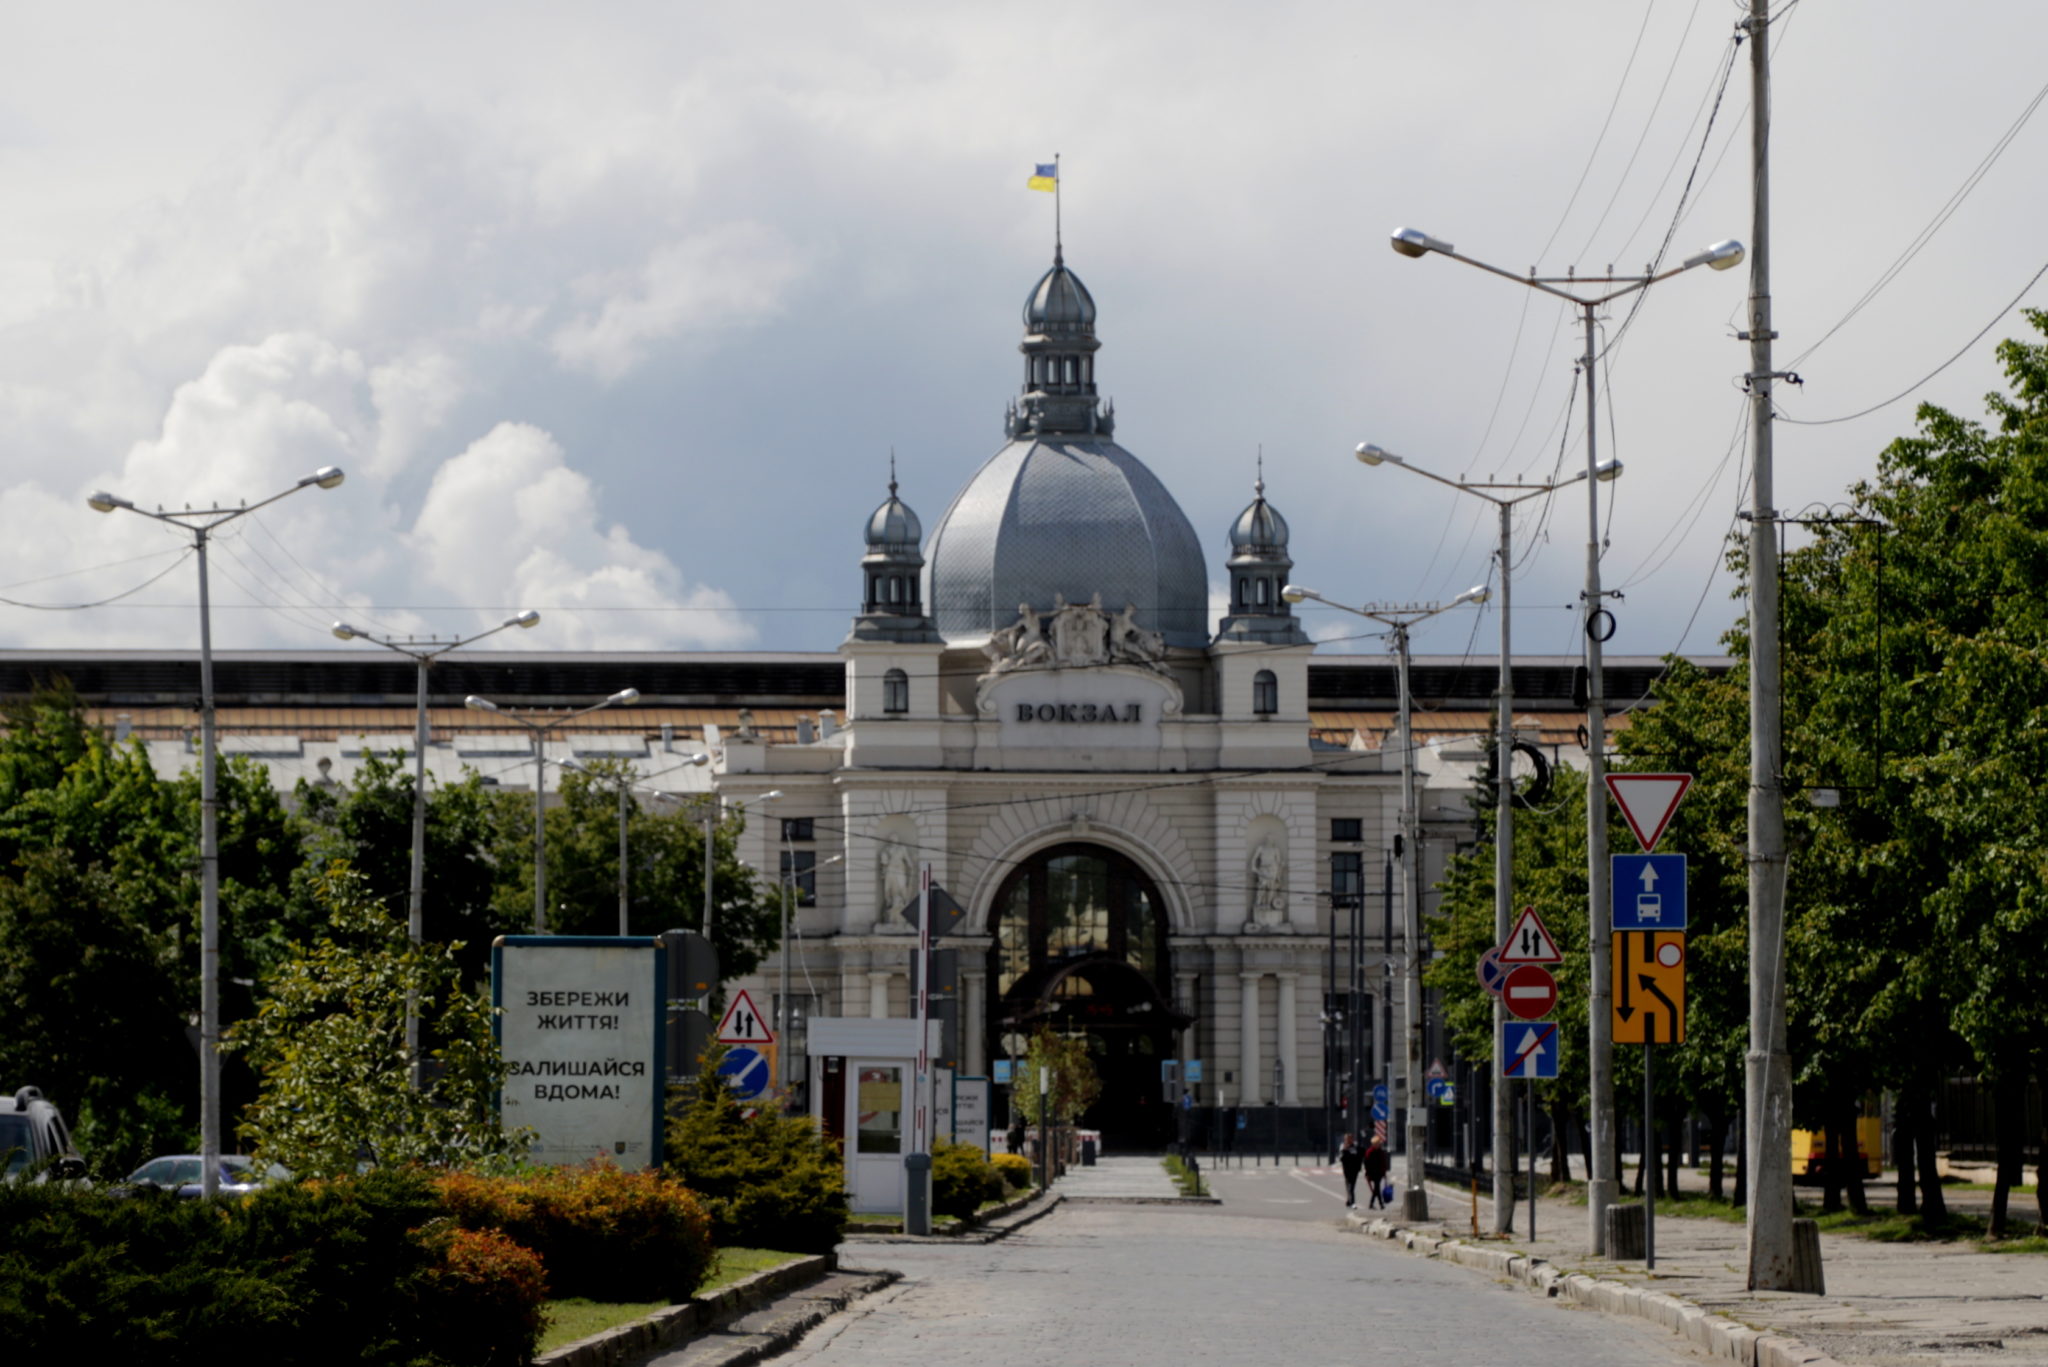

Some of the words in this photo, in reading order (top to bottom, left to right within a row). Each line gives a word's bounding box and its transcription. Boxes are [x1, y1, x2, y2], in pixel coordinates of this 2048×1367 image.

[1017, 703, 1142, 723] ВОКЗАЛ
[527, 991, 629, 1007] ЗБЕРЕЖИ
[537, 1015, 619, 1030] ЖИТТЯ!
[509, 1058, 645, 1076] ЗАЛИШАЙСЯ
[535, 1084, 620, 1101] ВДОМА!
